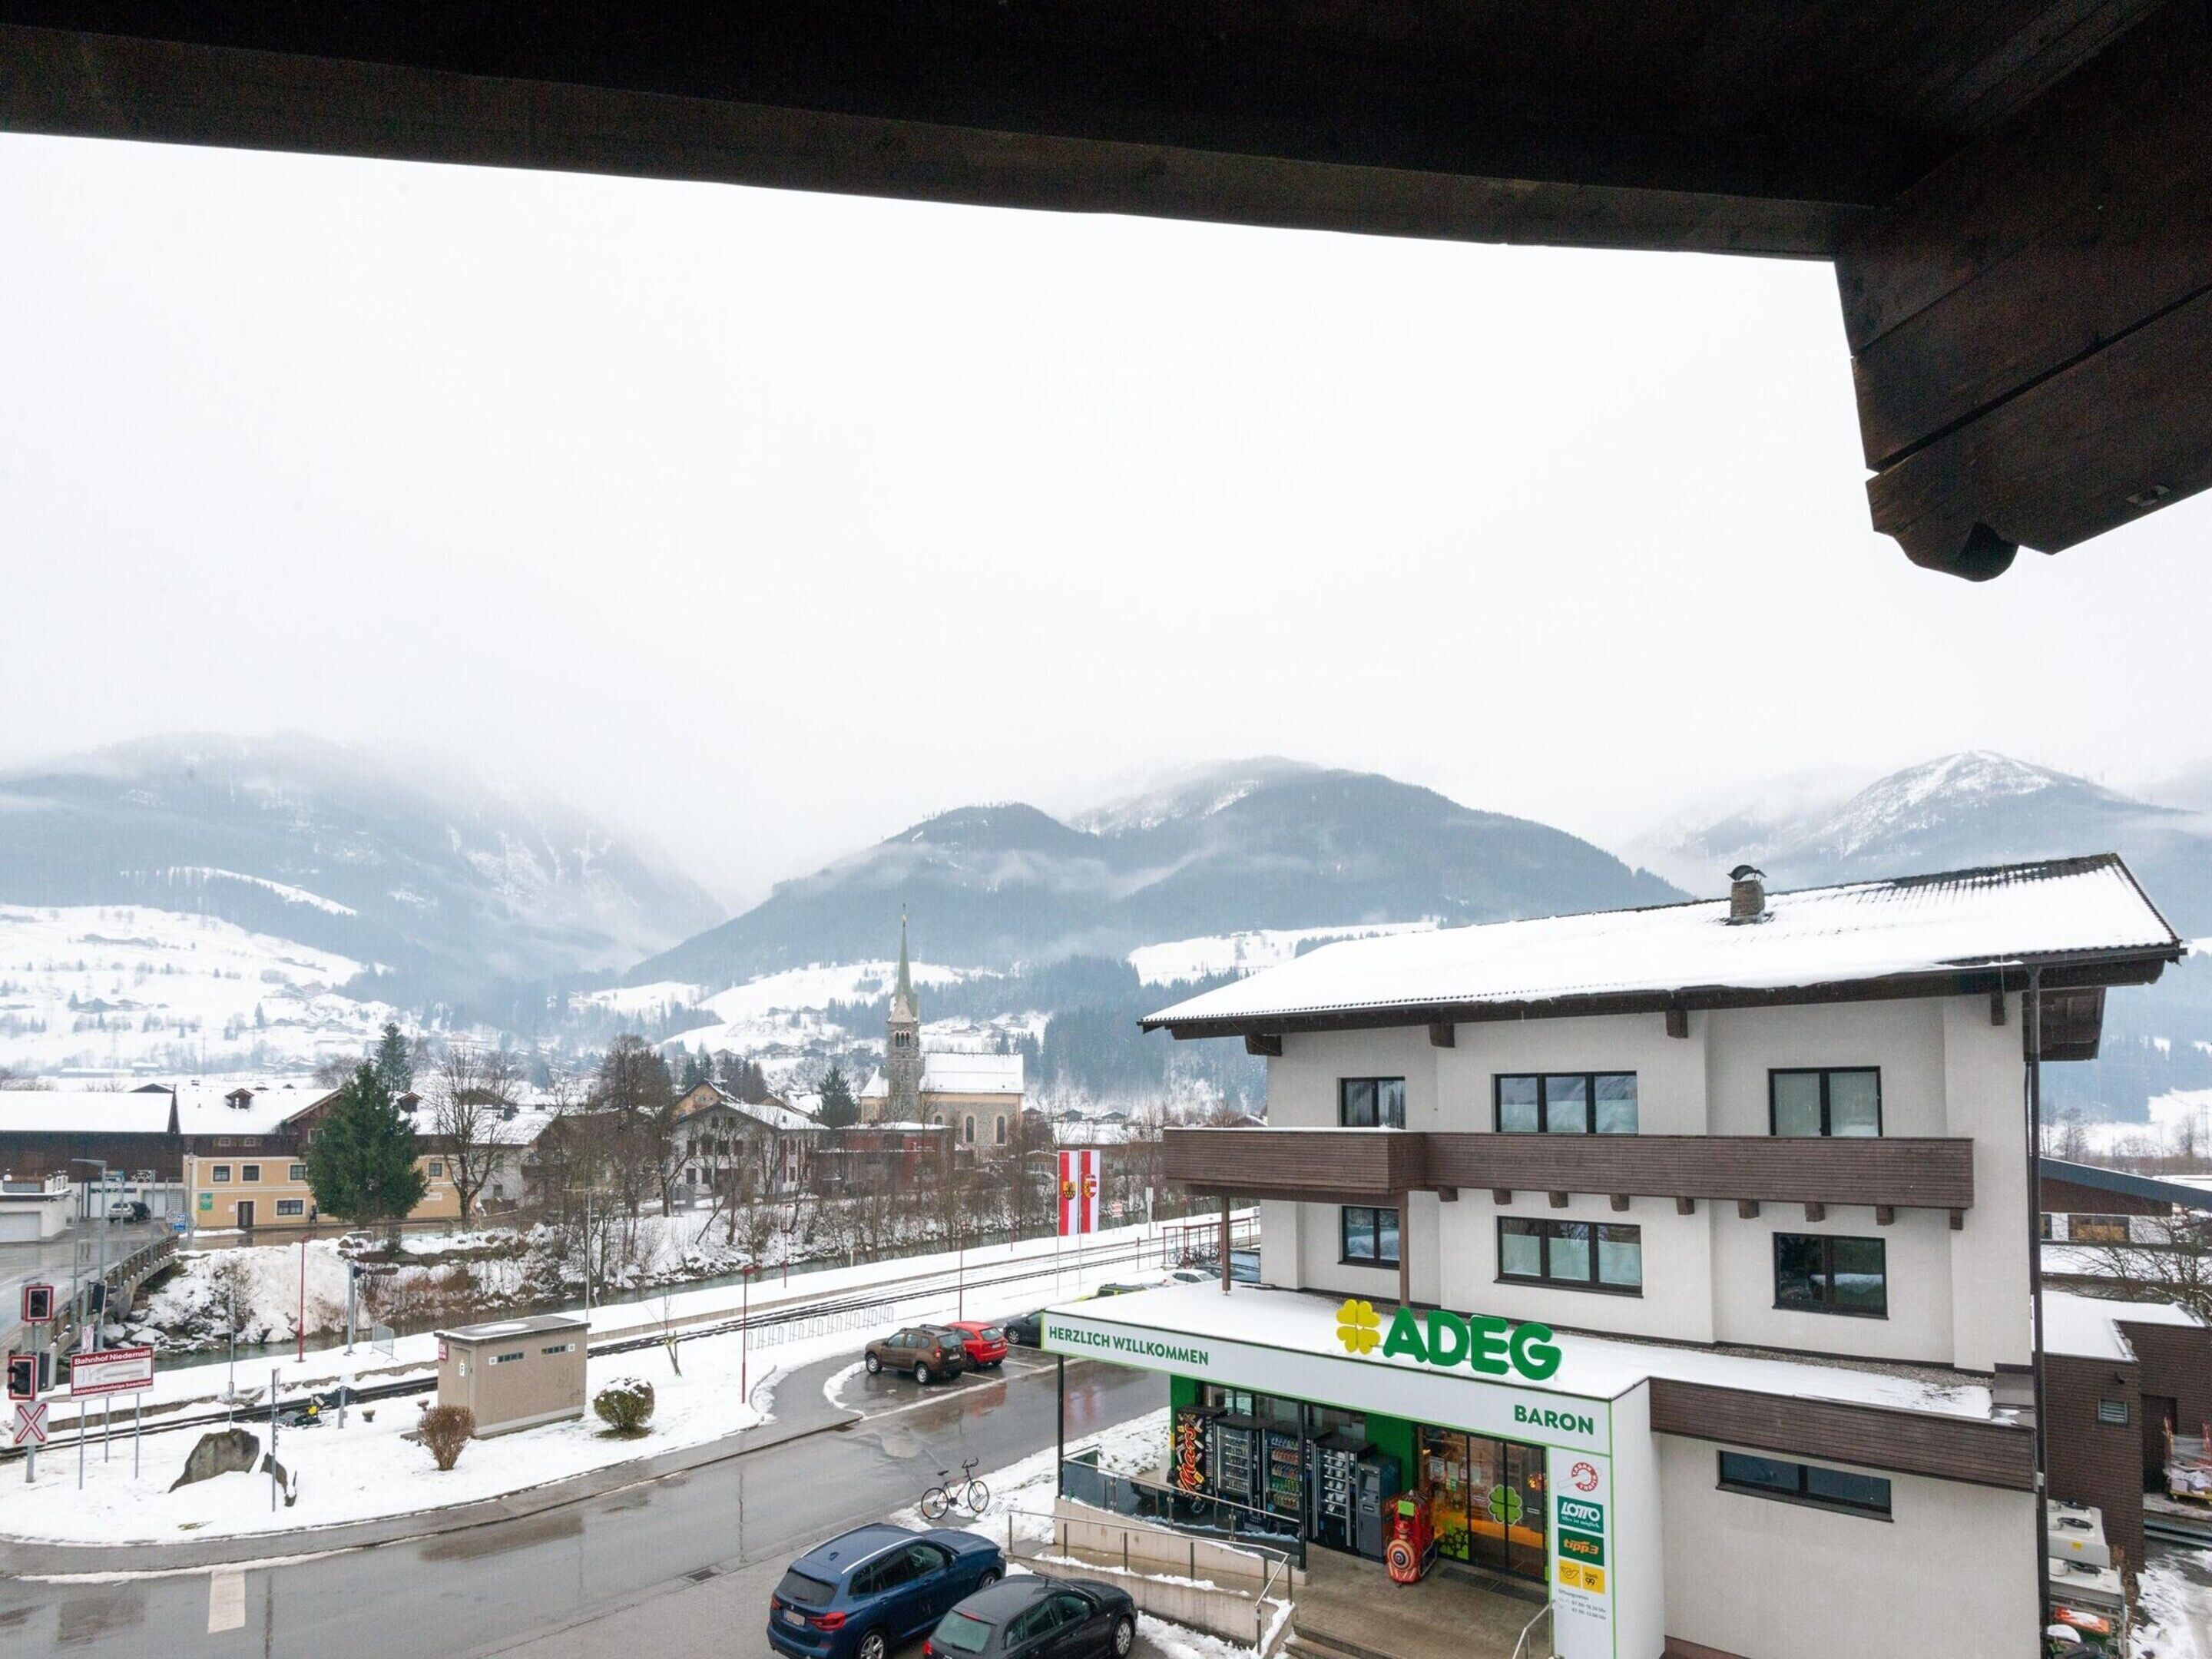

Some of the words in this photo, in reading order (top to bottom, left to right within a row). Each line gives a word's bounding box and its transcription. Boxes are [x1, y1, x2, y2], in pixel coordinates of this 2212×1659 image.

[1049, 1326, 1110, 1348] HERZLICH
[1113, 1336, 1209, 1366] WILLKOMMEN
[1382, 1306, 1562, 1381] ADEG
[75, 1355, 108, 1365] Bahnhof
[109, 1349, 151, 1360] Niedernsill
[1514, 1404, 1594, 1435] BARON
[1561, 1501, 1601, 1522] LOTTO
[1584, 1577, 1596, 1586] 99
